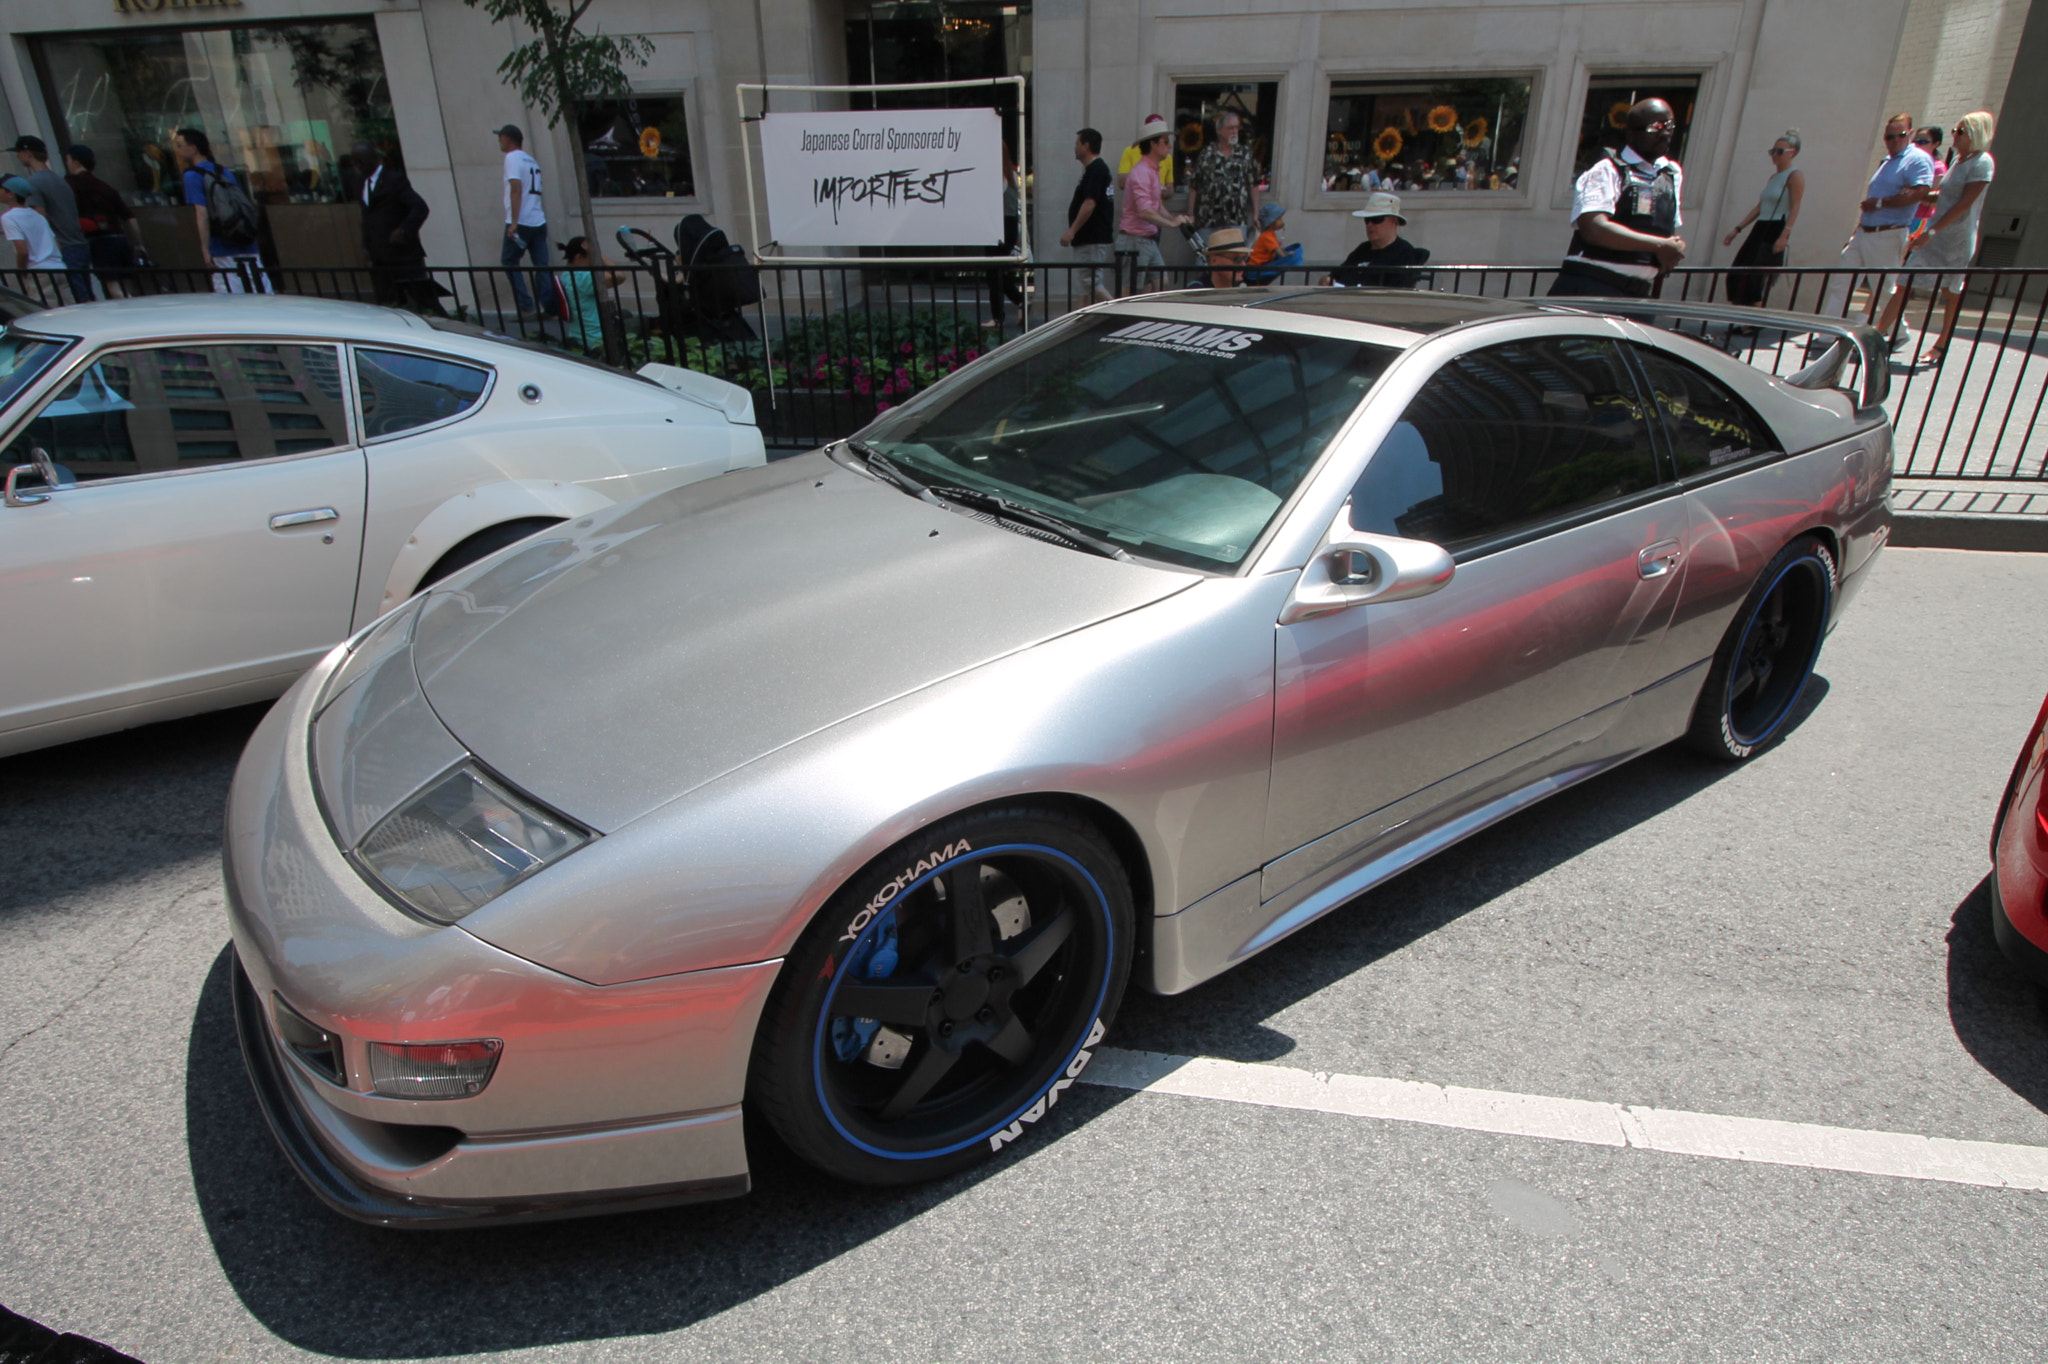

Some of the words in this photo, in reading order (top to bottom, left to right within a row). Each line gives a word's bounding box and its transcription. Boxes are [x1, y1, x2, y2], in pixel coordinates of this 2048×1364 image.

[801, 129, 850, 154] Japanese
[853, 128, 885, 151] Corral
[887, 127, 946, 153] Sponsored
[947, 127, 962, 152] by
[813, 168, 976, 226] IMPORTFEST
[1720, 713, 1753, 757] ADVAN
[839, 838, 972, 943] YOKOHAMA
[989, 1017, 1106, 1152] ADVAN
